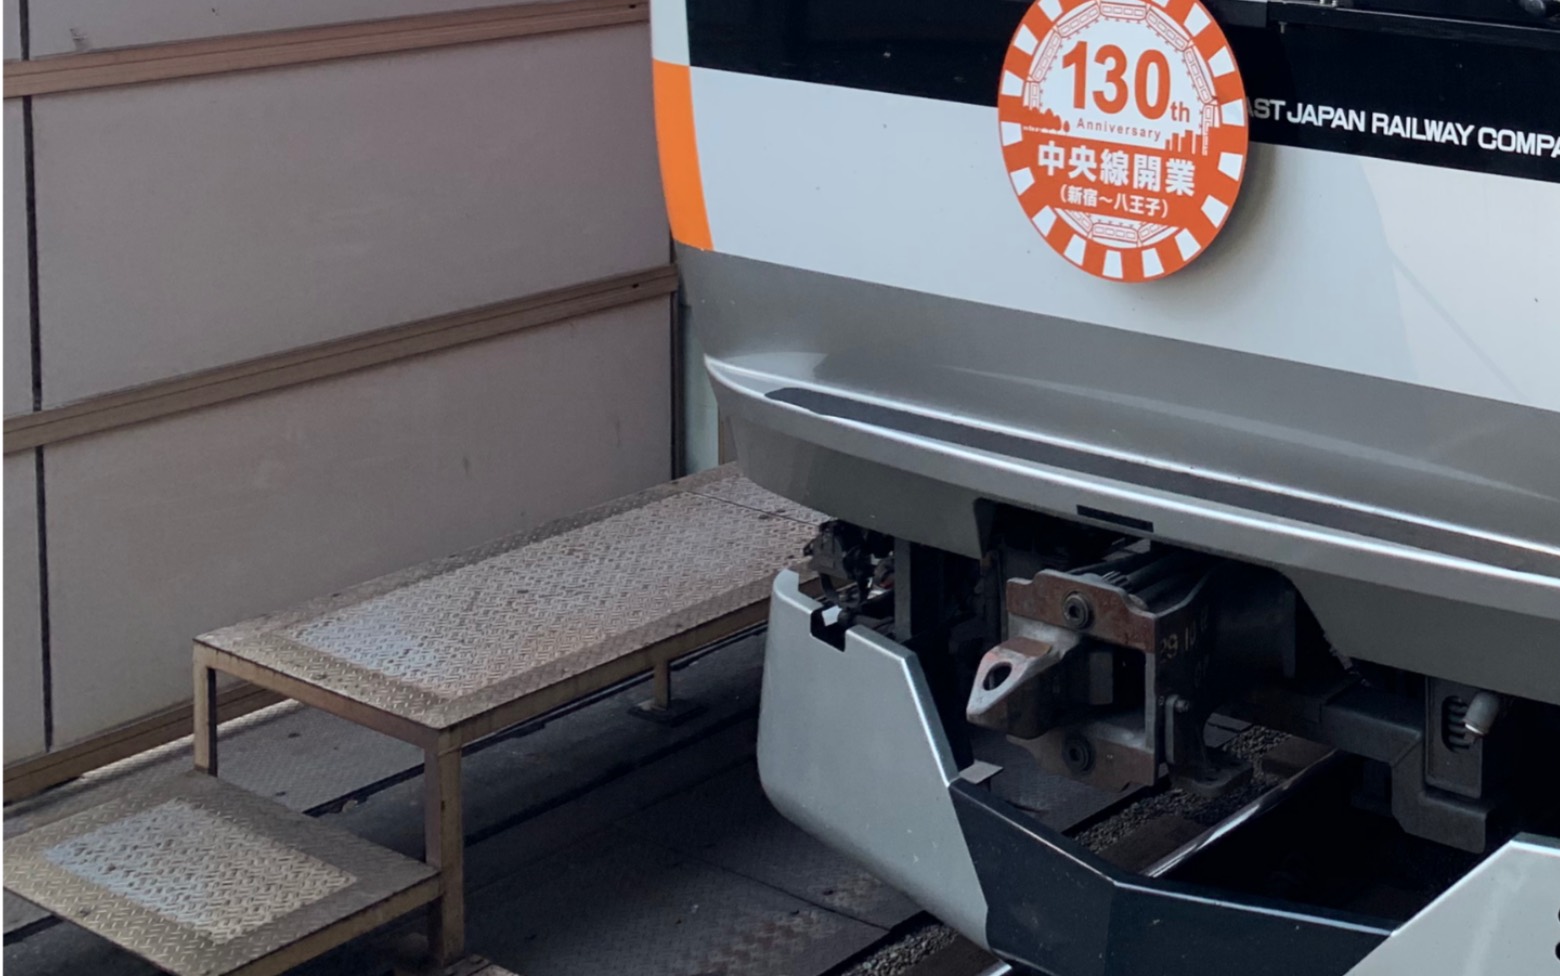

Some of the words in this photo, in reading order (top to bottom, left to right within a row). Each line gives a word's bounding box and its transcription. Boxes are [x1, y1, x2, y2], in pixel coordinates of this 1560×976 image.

[1077, 118, 1161, 142] Anniversary
[1247, 97, 1286, 121] ST
[1286, 103, 1365, 132] JAPAN
[1371, 112, 1475, 146] RAILWAY
[1038, 140, 1195, 197] 中央線開業
